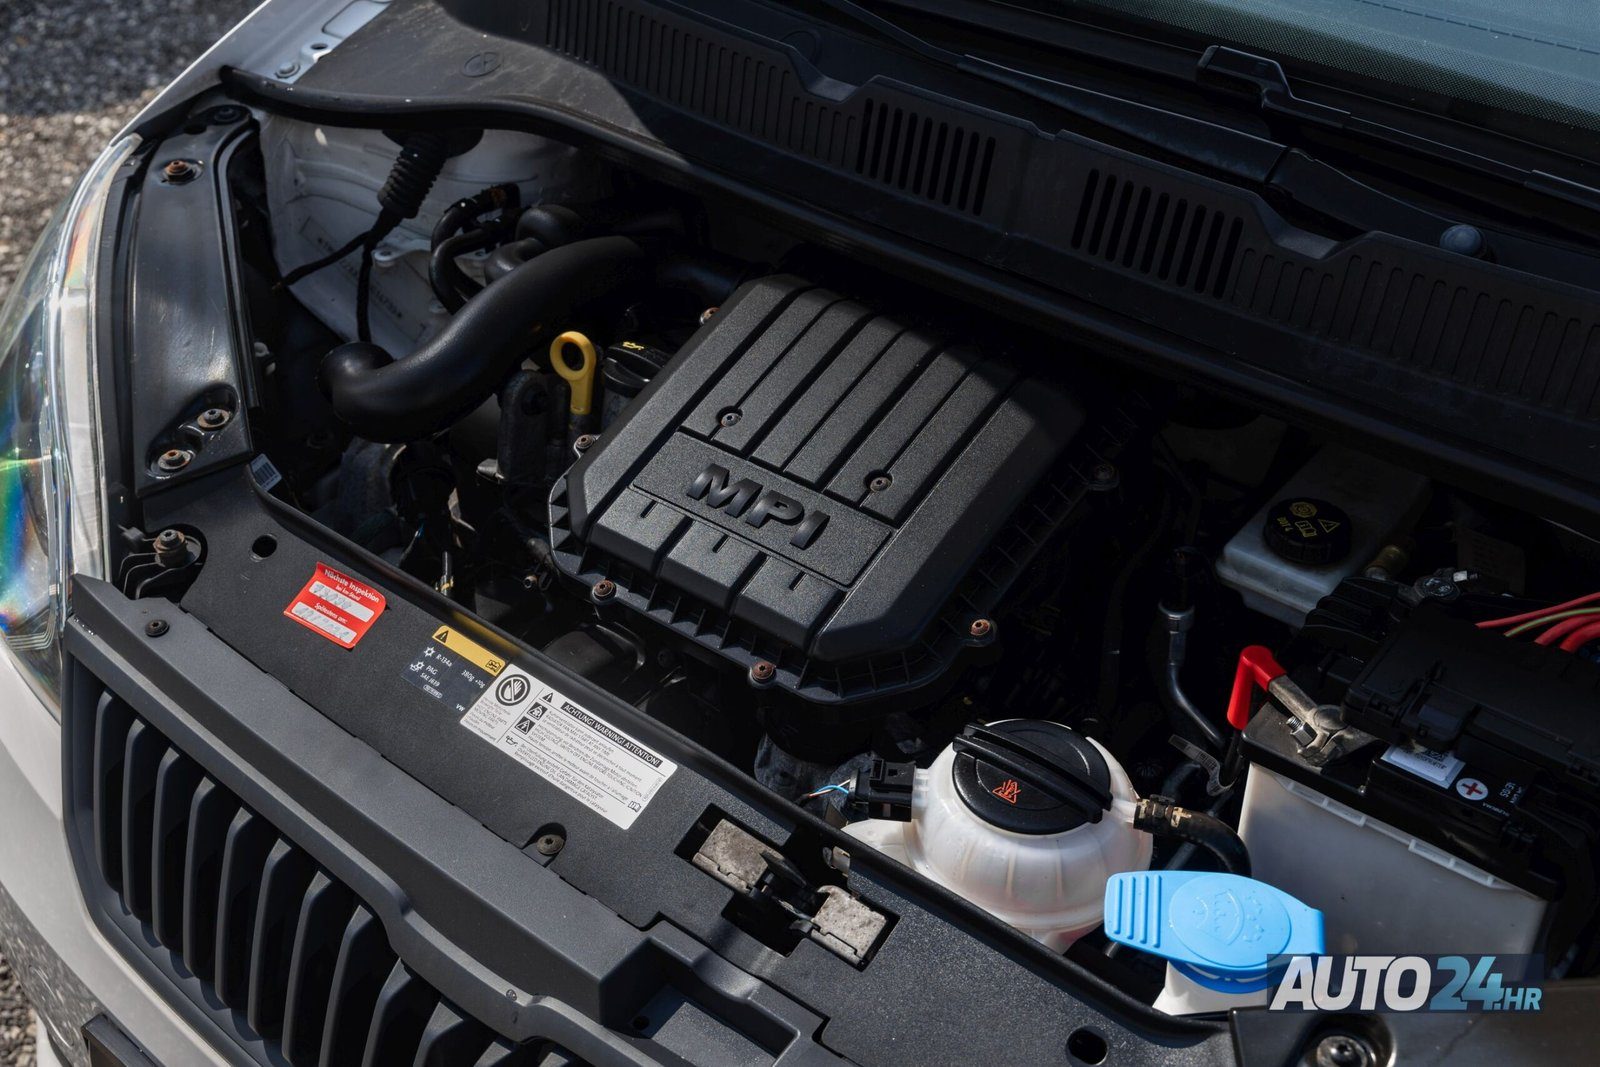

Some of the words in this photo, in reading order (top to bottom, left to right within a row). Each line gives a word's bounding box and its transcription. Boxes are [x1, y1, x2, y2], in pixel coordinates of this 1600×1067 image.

[686, 463, 830, 550] MPI
[324, 569, 349, 587] Nächste
[349, 581, 380, 603] Inspektion
[314, 602, 338, 620] Spätestens
[435, 654, 453, 667] R-134a
[420, 672, 431, 682] SAE
[426, 665, 439, 676] PAG
[456, 703, 466, 712] VW
[563, 703, 595, 726] ACHTUNG!
[593, 722, 625, 744] WARNING!
[623, 740, 660, 766] ATTENTION!
